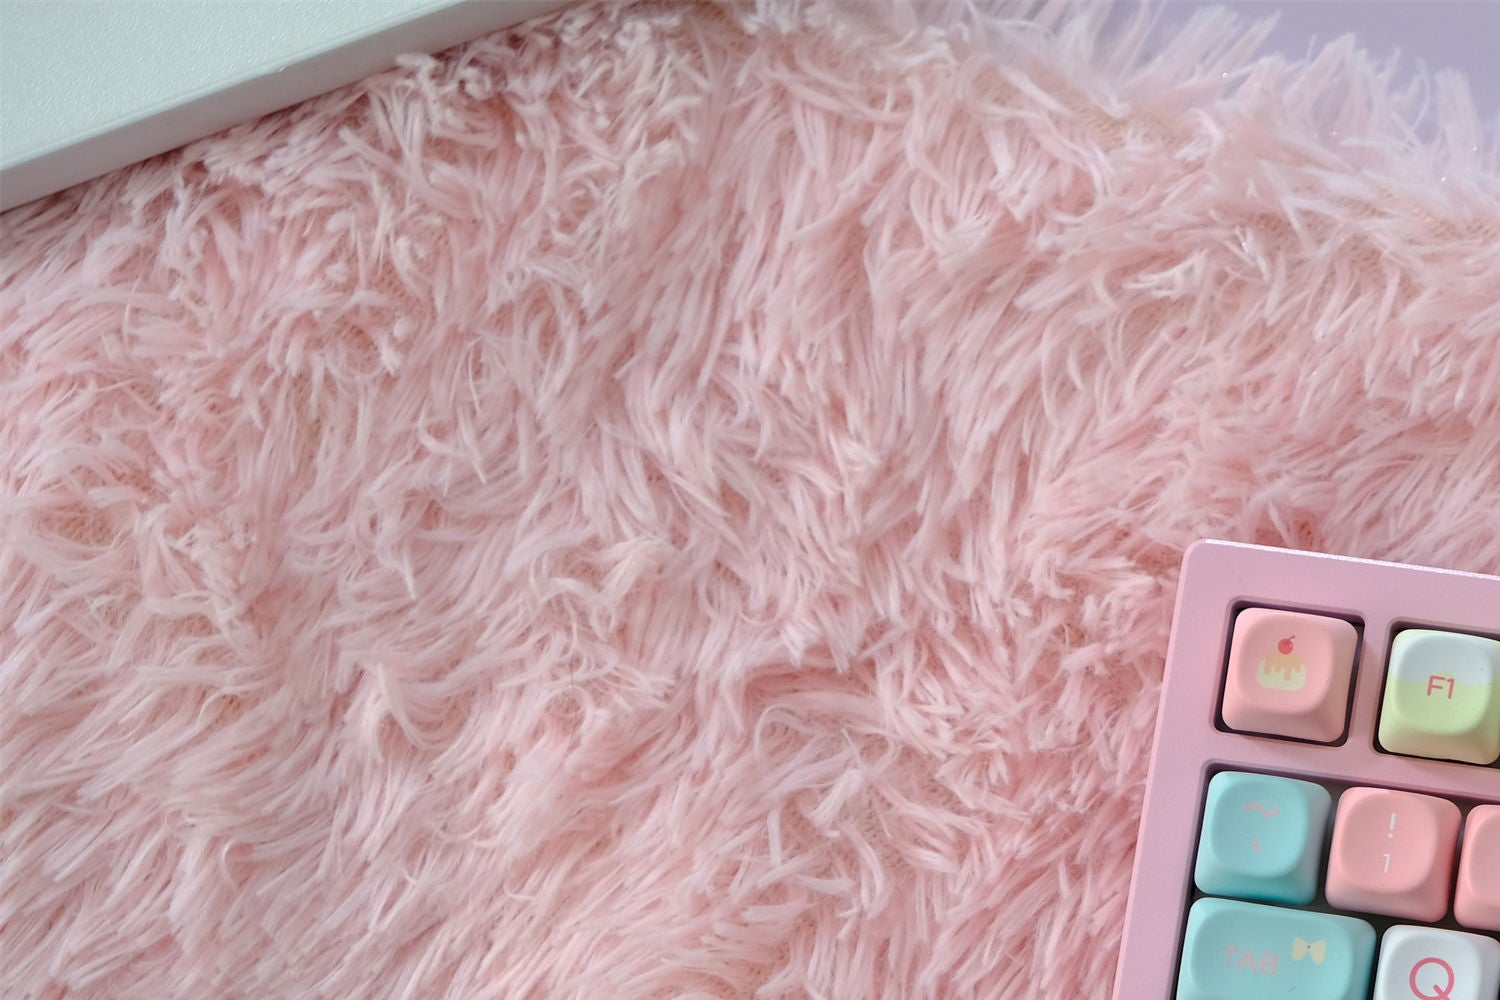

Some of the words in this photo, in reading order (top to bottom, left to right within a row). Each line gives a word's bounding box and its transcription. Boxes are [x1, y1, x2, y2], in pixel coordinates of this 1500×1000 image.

[1426, 674, 1456, 699] F1
[1383, 852, 1391, 873] 1
[1222, 944, 1280, 976] TAB
